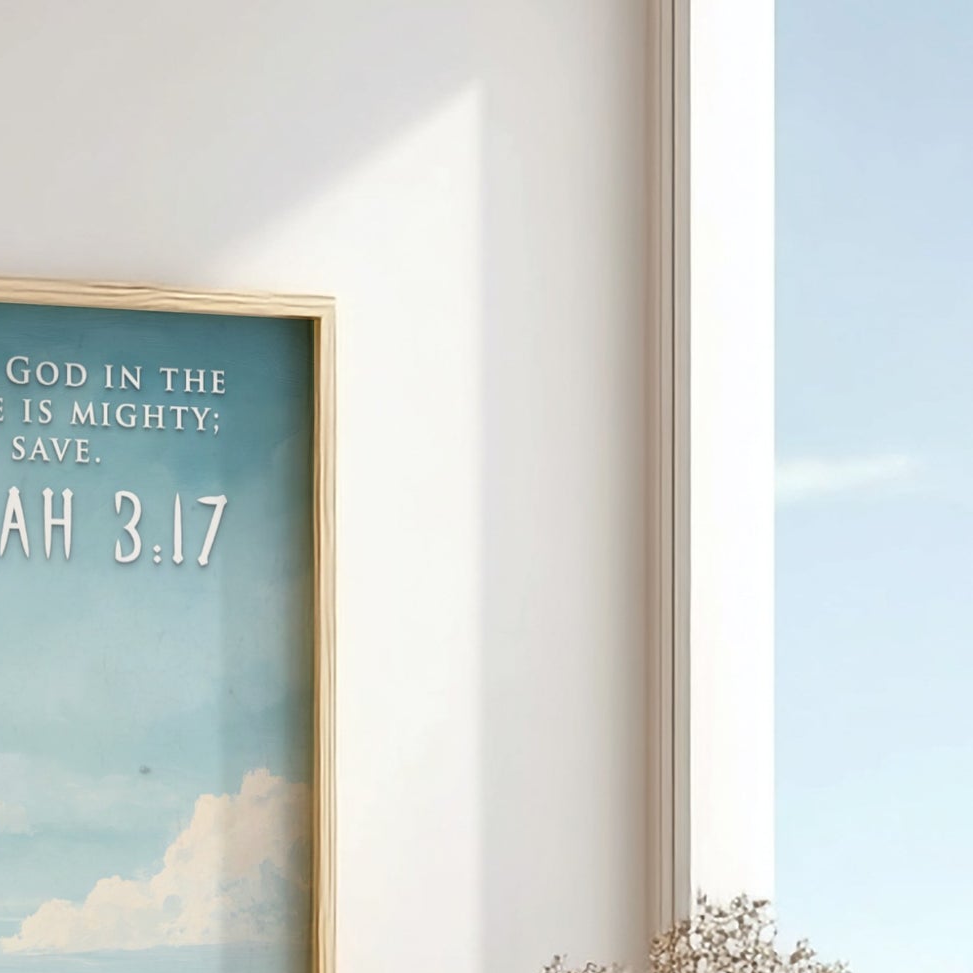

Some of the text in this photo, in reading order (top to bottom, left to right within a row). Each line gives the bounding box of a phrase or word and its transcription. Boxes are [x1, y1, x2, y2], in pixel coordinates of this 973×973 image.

[6, 356, 88, 387] GOD
[104, 365, 142, 390] IN
[160, 368, 226, 394] THE
[23, 399, 52, 424] IS
[71, 401, 220, 434] MIGHTY;
[12, 436, 101, 463] SAVE.
[115, 491, 228, 566] 3:17
